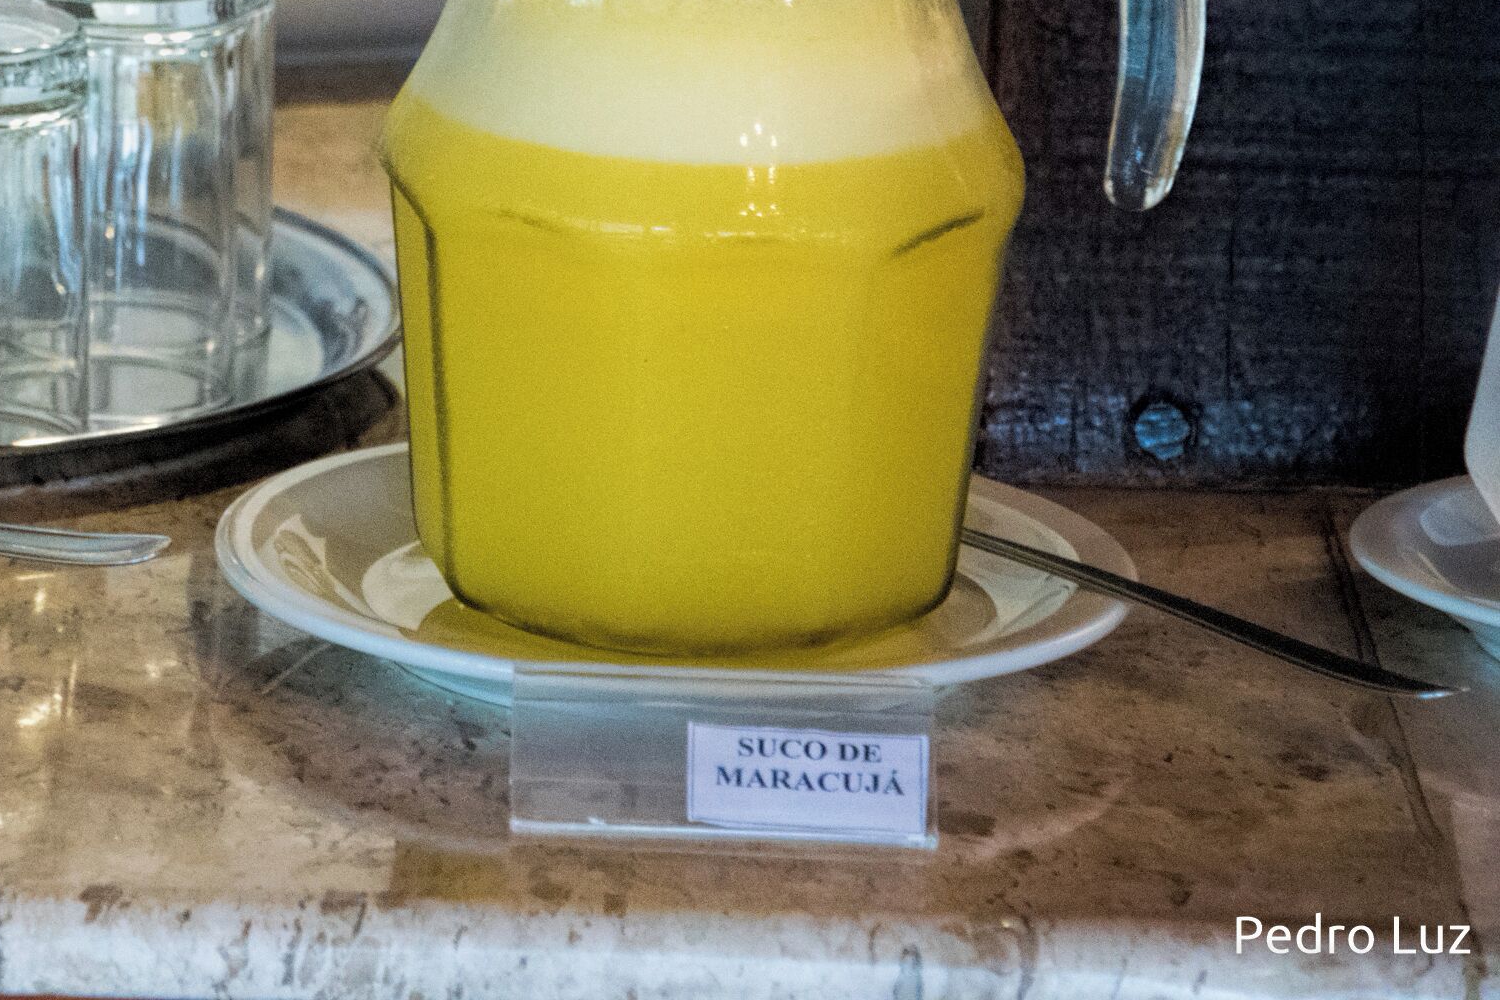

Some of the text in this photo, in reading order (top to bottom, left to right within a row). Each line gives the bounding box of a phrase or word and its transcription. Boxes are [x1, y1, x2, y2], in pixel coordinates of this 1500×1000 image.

[737, 737, 883, 763] SUCO DE
[715, 765, 905, 796] MARACUJÁ
